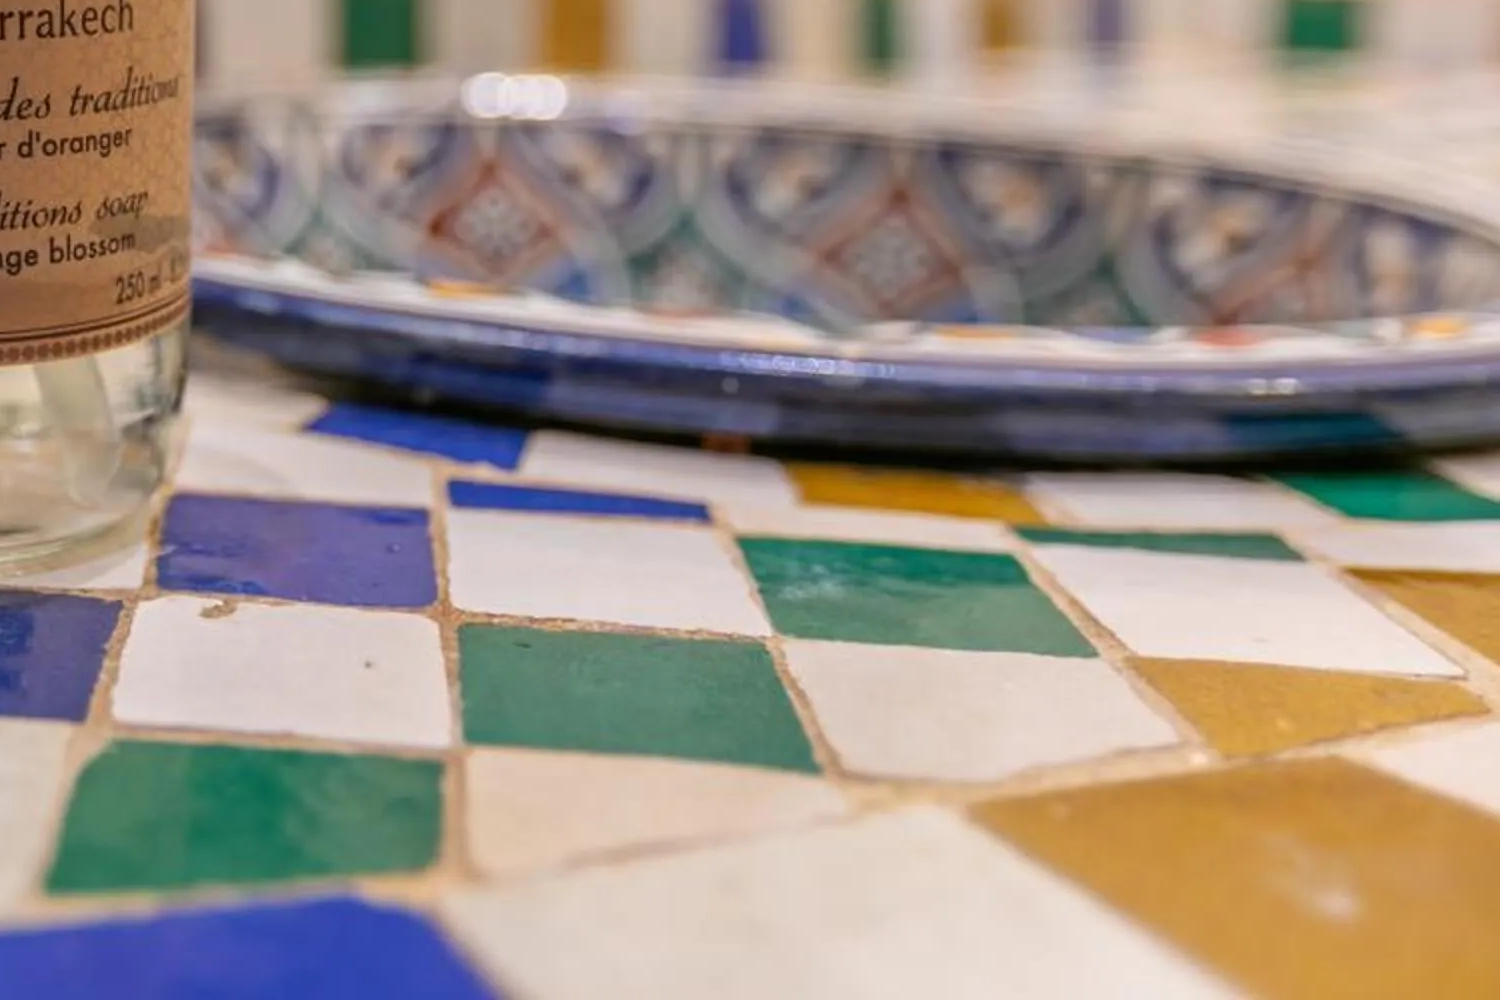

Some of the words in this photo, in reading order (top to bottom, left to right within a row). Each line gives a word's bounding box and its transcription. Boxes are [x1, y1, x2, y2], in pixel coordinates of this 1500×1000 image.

[18, 128, 134, 160] d'oranger
[96, 191, 149, 220] soap
[49, 233, 136, 265] blossom
[116, 271, 145, 305] 250
